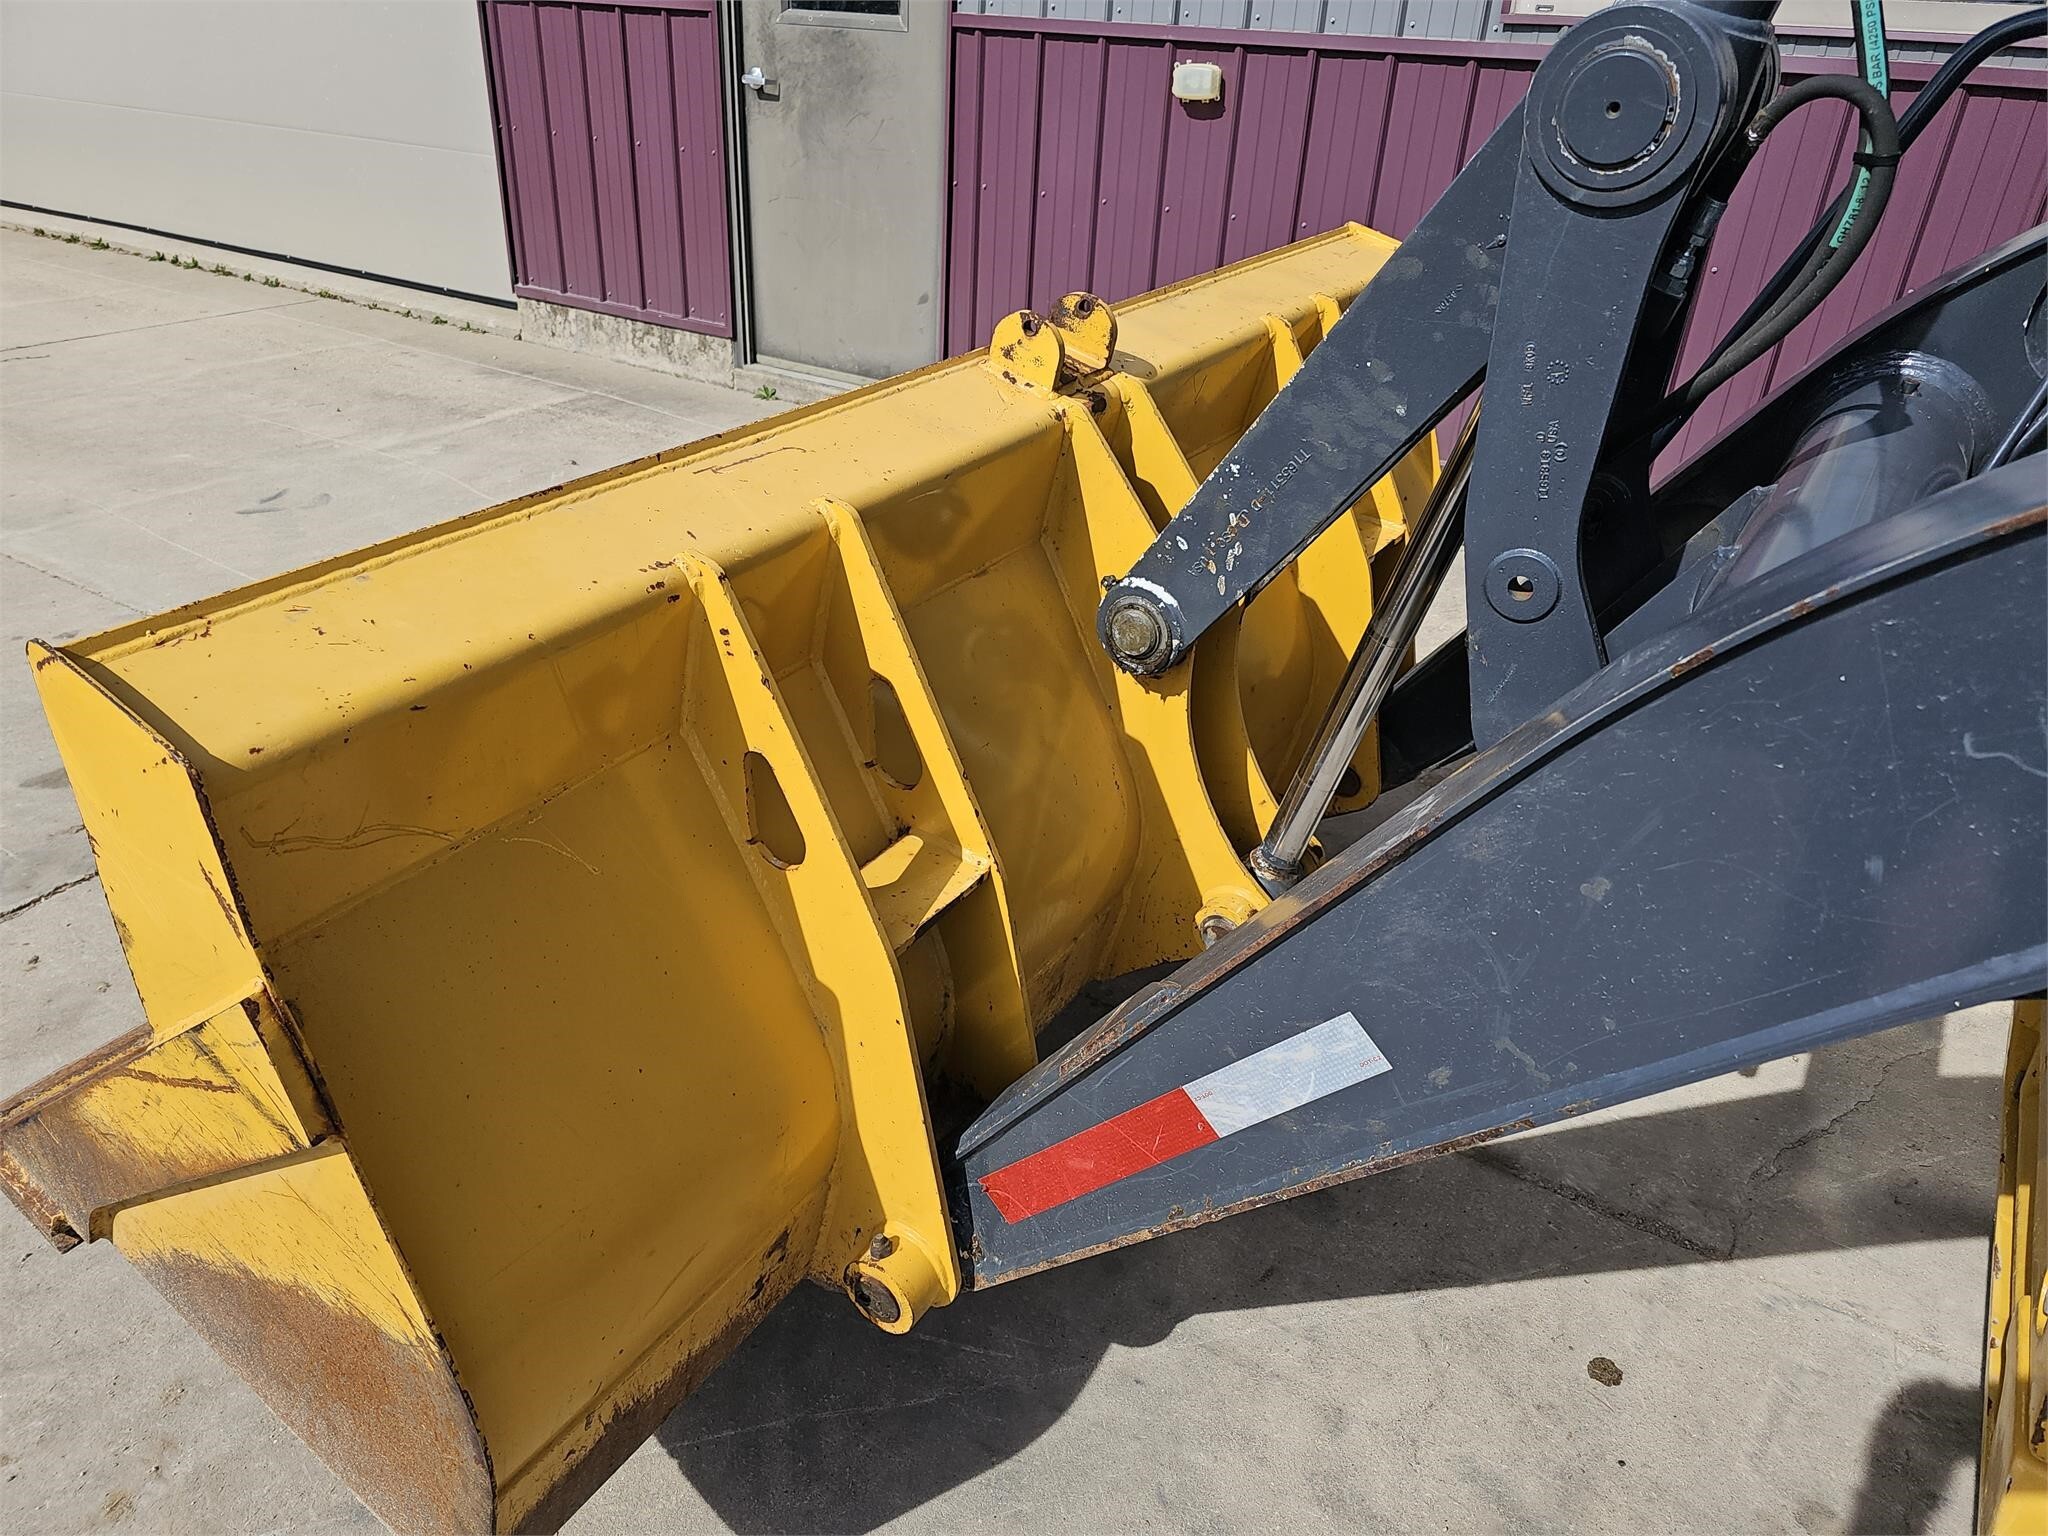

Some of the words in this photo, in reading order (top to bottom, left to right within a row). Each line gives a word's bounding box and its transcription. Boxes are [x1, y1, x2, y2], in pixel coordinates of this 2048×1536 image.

[1865, 0, 1877, 17] PS
[1867, 21, 1881, 51] (4250
[1870, 54, 1883, 79] BAR
[1547, 419, 1561, 443] USA
[1359, 1055, 1382, 1068] DOT-C2
